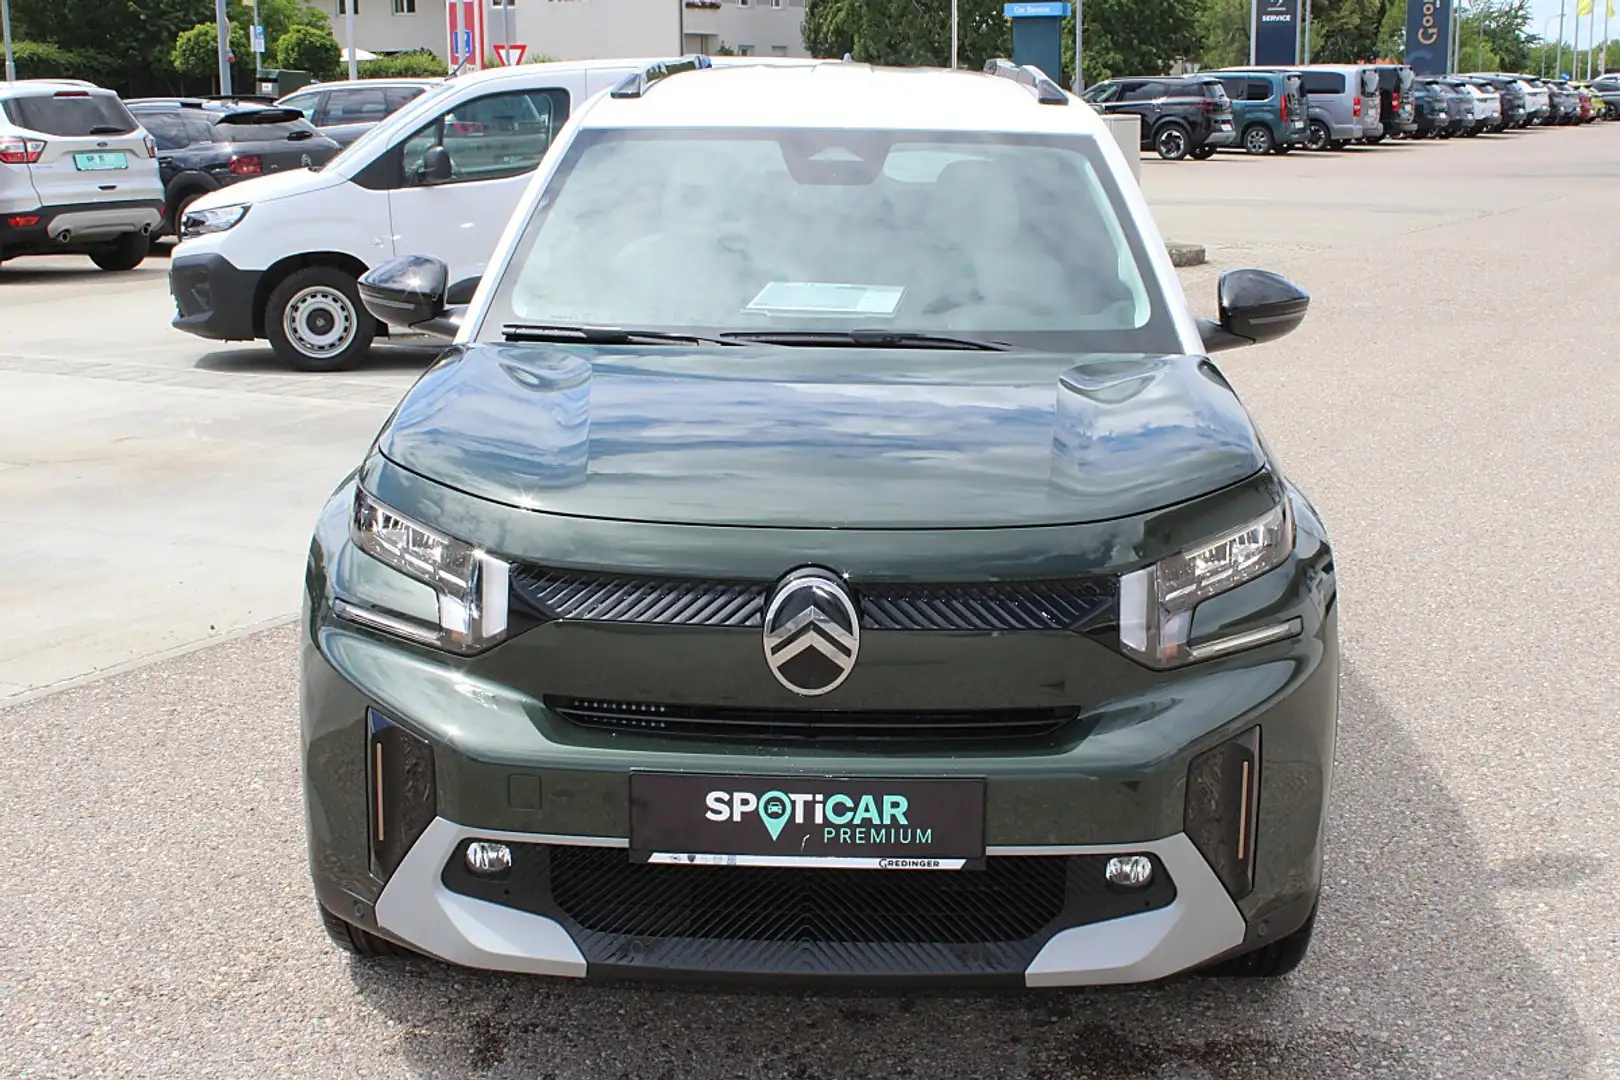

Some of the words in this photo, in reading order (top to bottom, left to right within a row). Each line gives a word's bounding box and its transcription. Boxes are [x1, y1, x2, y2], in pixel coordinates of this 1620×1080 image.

[1262, 14, 1291, 22] SERVICE
[1418, 0, 1437, 44] Goo
[823, 826, 933, 844] PREMIUM
[879, 858, 940, 868] GREDINGER
